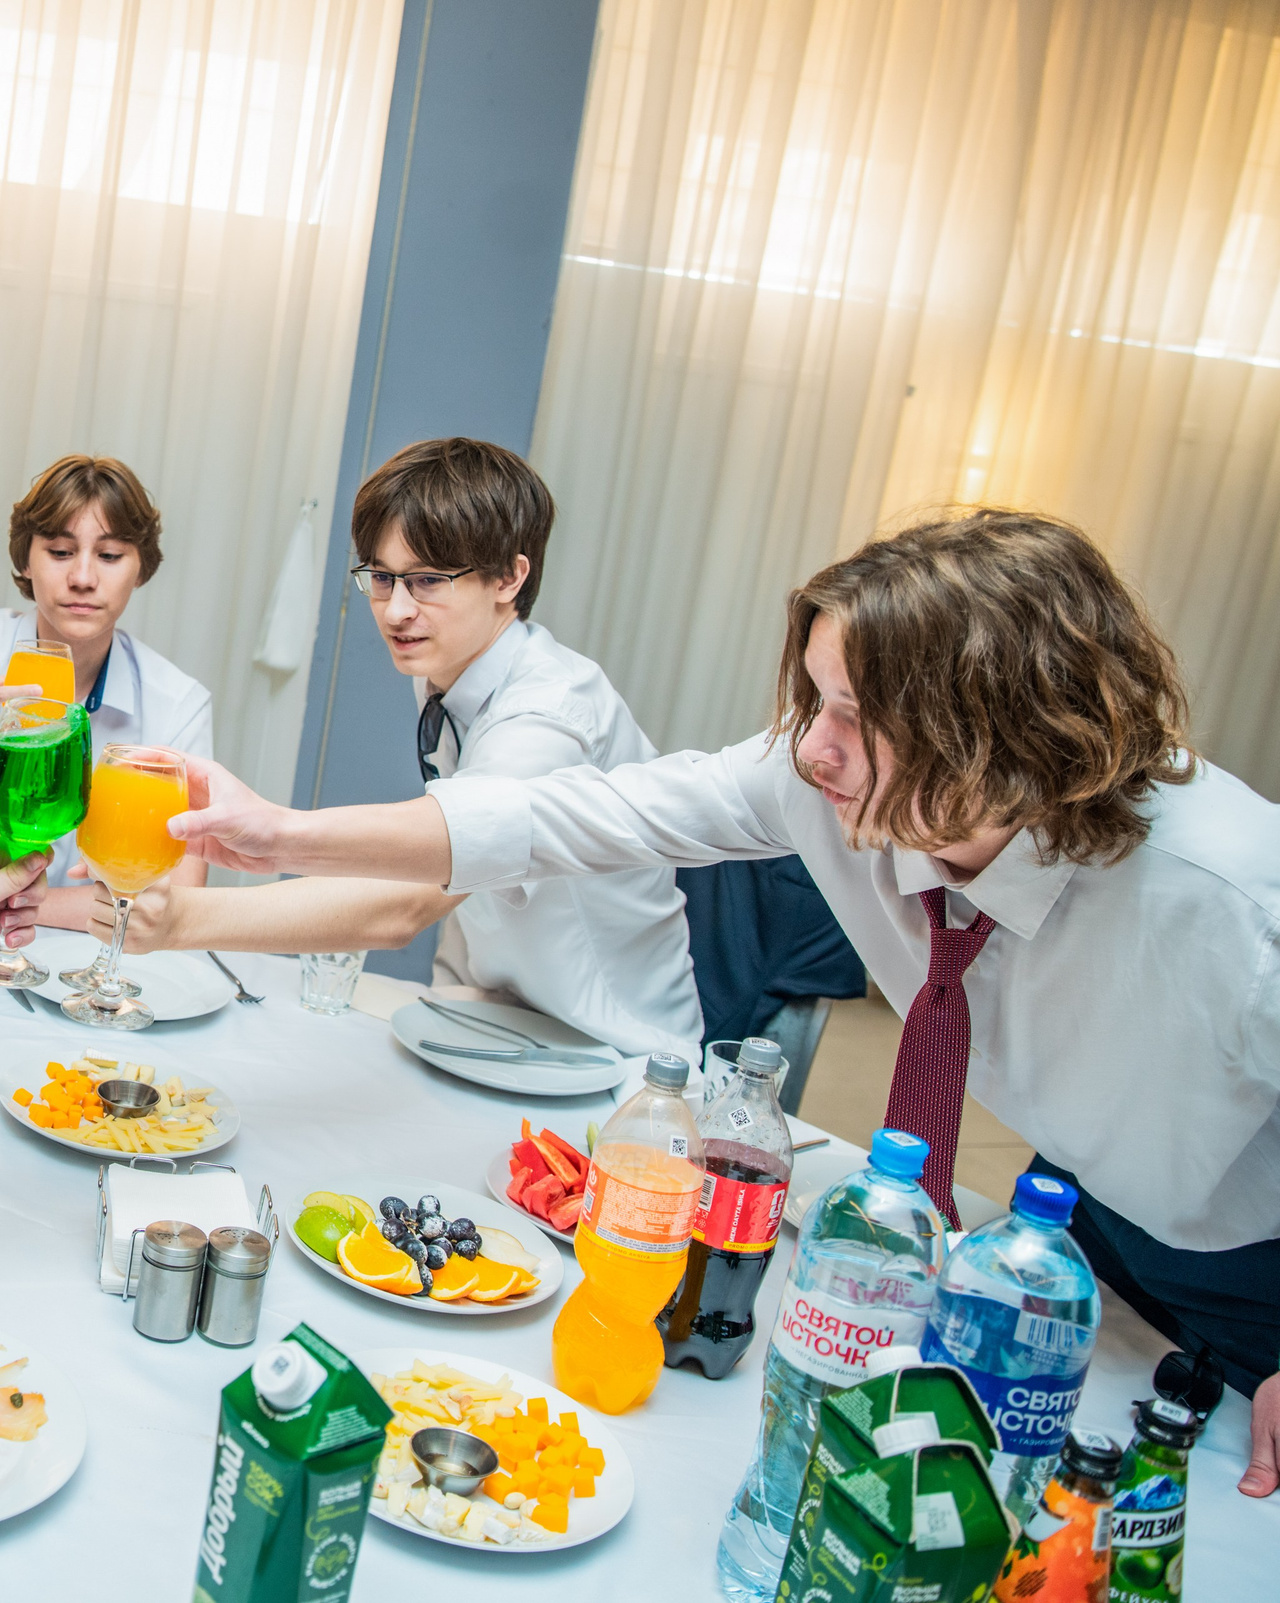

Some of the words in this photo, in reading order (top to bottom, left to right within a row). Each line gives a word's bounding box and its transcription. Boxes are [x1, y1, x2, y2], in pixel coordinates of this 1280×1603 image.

[782, 1310, 870, 1368] ИСТОЧН
[795, 1299, 895, 1348] СВЯТОЙ
[795, 1349, 869, 1380] НЕГАЗИРОВАННАЯ
[1109, 1586, 1169, 1603] ФЕЙХ
